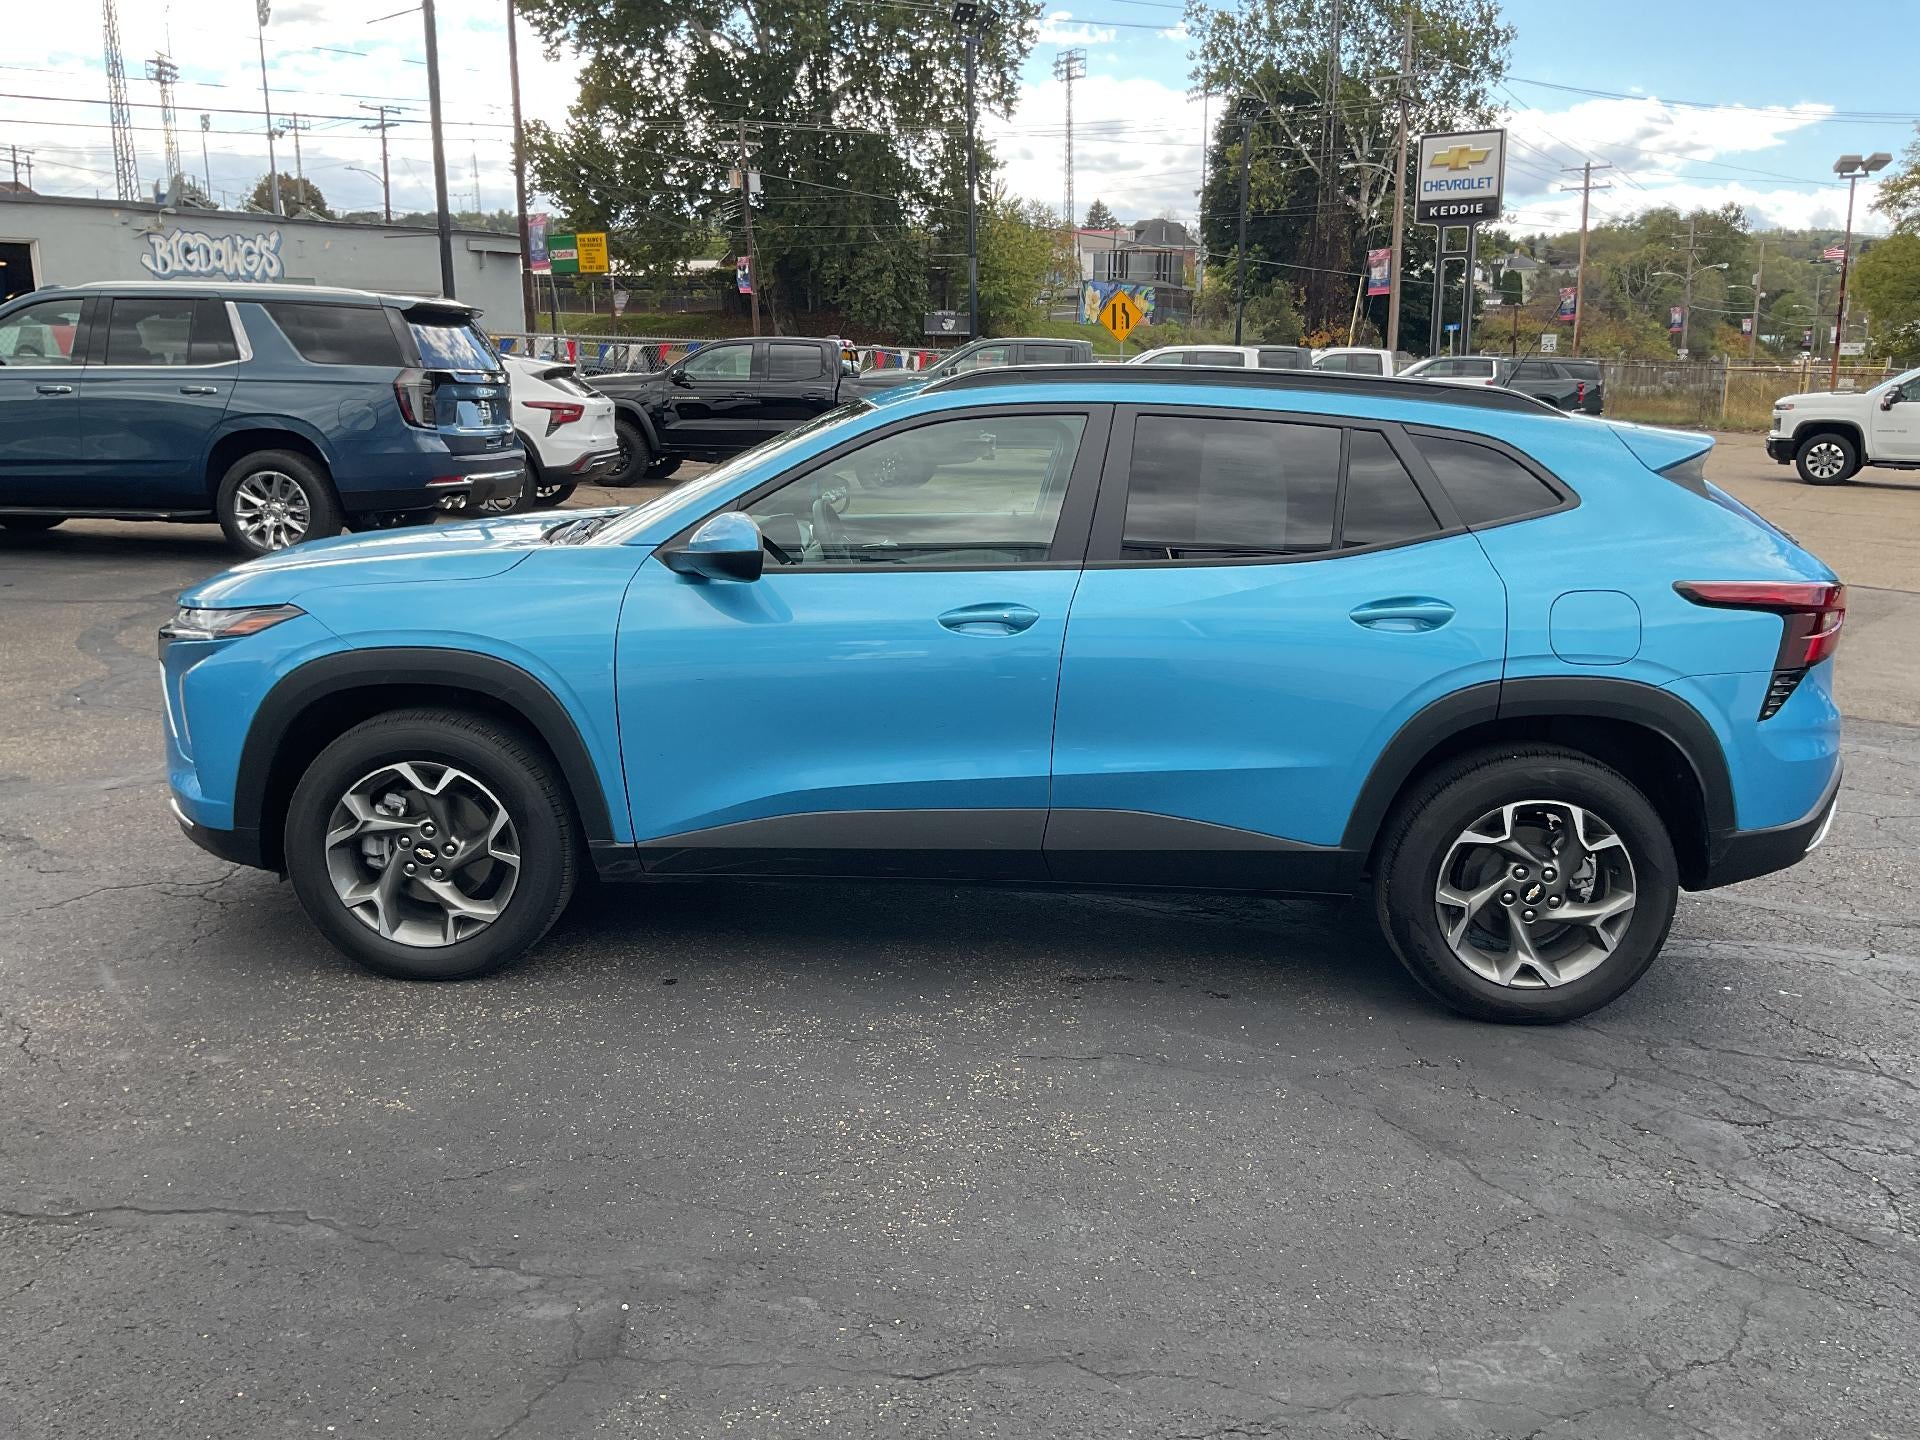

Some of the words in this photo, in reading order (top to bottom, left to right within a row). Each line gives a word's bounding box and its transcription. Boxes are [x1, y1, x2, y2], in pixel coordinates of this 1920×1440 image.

[1423, 176, 1493, 192] CHEVROLET
[1429, 203, 1484, 217] KEDDIE
[1542, 343, 1555, 351] 25
